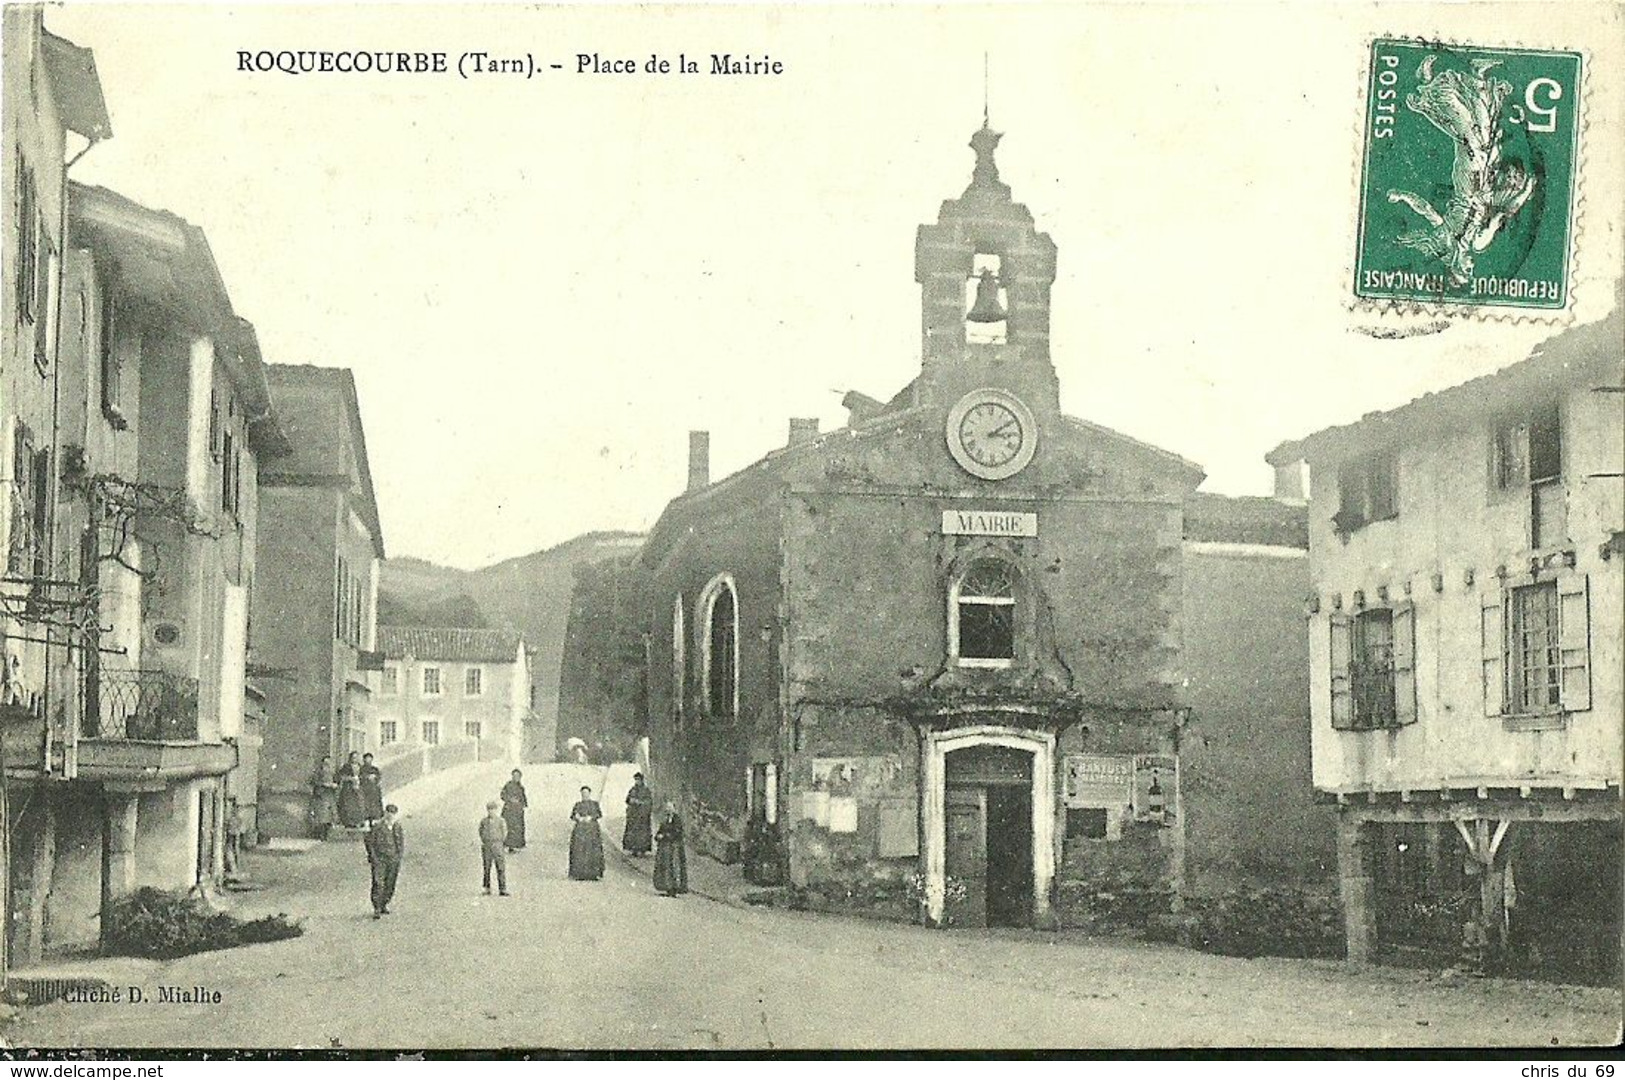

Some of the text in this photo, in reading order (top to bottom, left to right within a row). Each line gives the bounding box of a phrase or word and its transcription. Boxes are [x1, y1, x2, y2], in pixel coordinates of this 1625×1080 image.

[237, 51, 447, 76] ROQUECOURBE
[459, 53, 542, 79] (Tarn).
[577, 54, 636, 74] Place
[645, 54, 670, 74] de
[680, 54, 699, 74] la
[711, 54, 784, 75] Mairie
[1375, 55, 1399, 139] POSTES
[957, 514, 1023, 533] MAIRIE
[61, 985, 222, 1004] Cliché D. Mialhe
